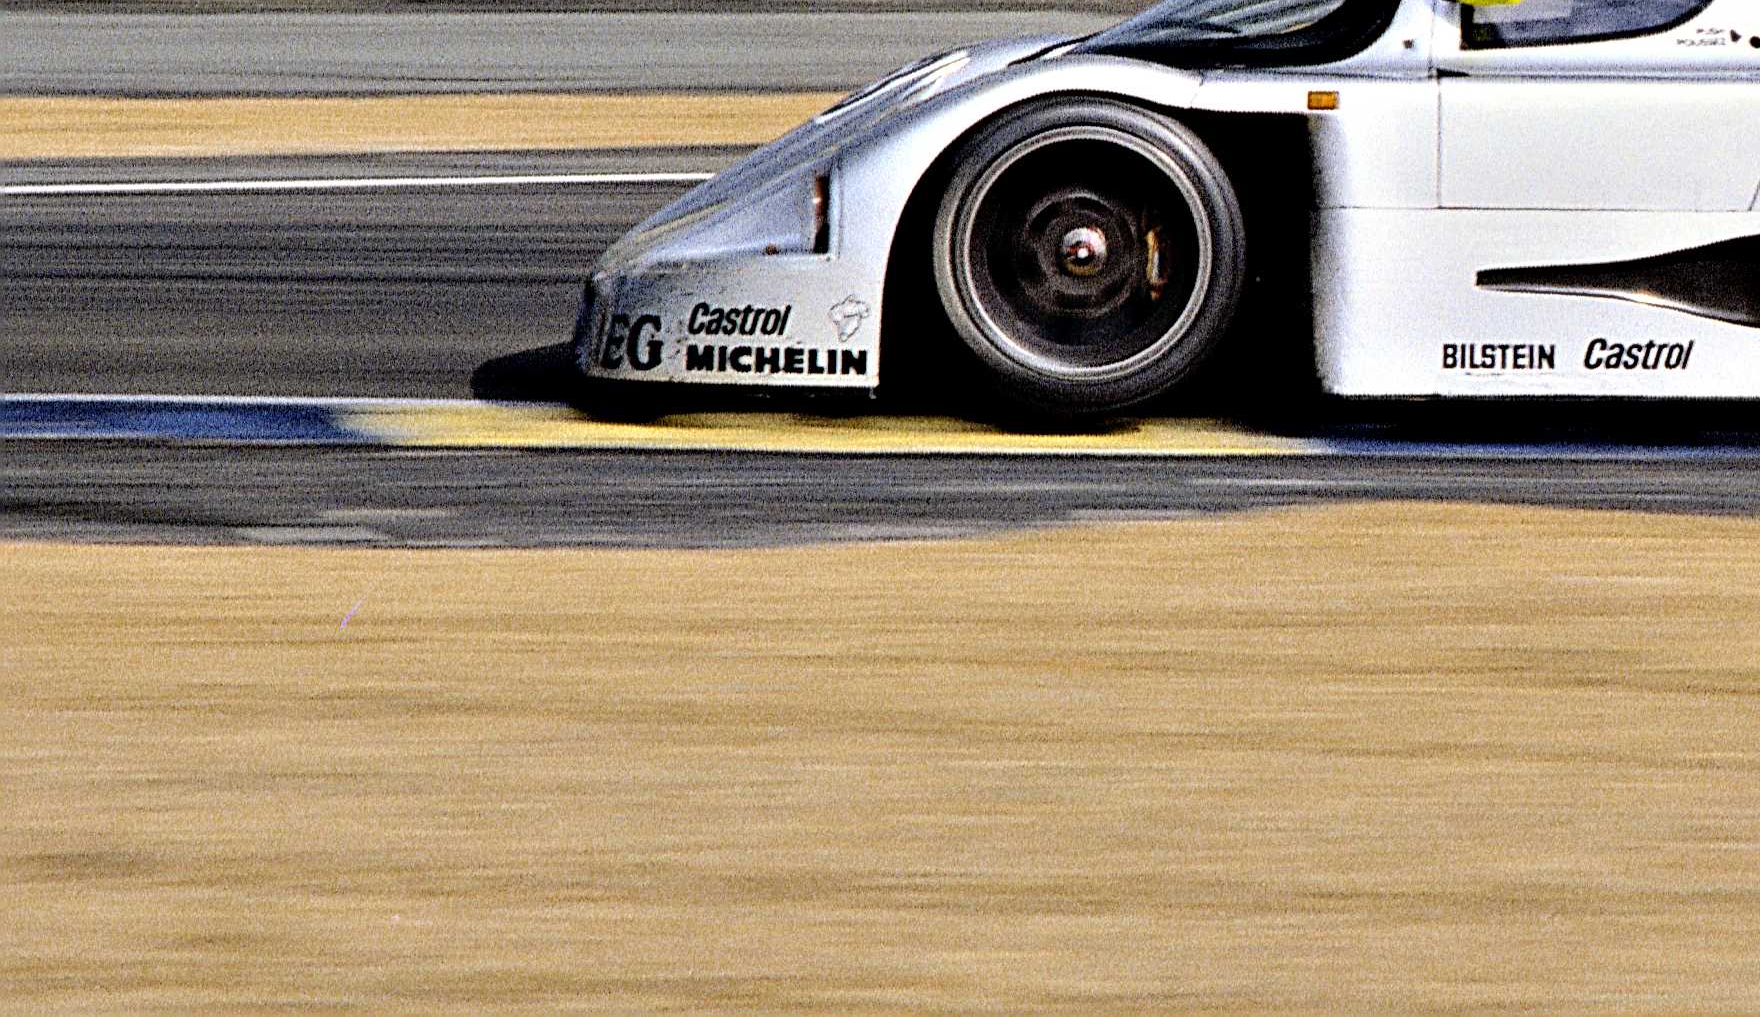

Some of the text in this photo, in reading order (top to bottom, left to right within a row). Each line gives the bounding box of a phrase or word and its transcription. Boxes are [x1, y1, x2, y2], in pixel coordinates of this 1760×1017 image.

[687, 301, 793, 337] Castrol
[685, 343, 868, 376] MICHELIN
[1442, 343, 1555, 370] BILSTEIN
[1583, 337, 1695, 371] Castrol
